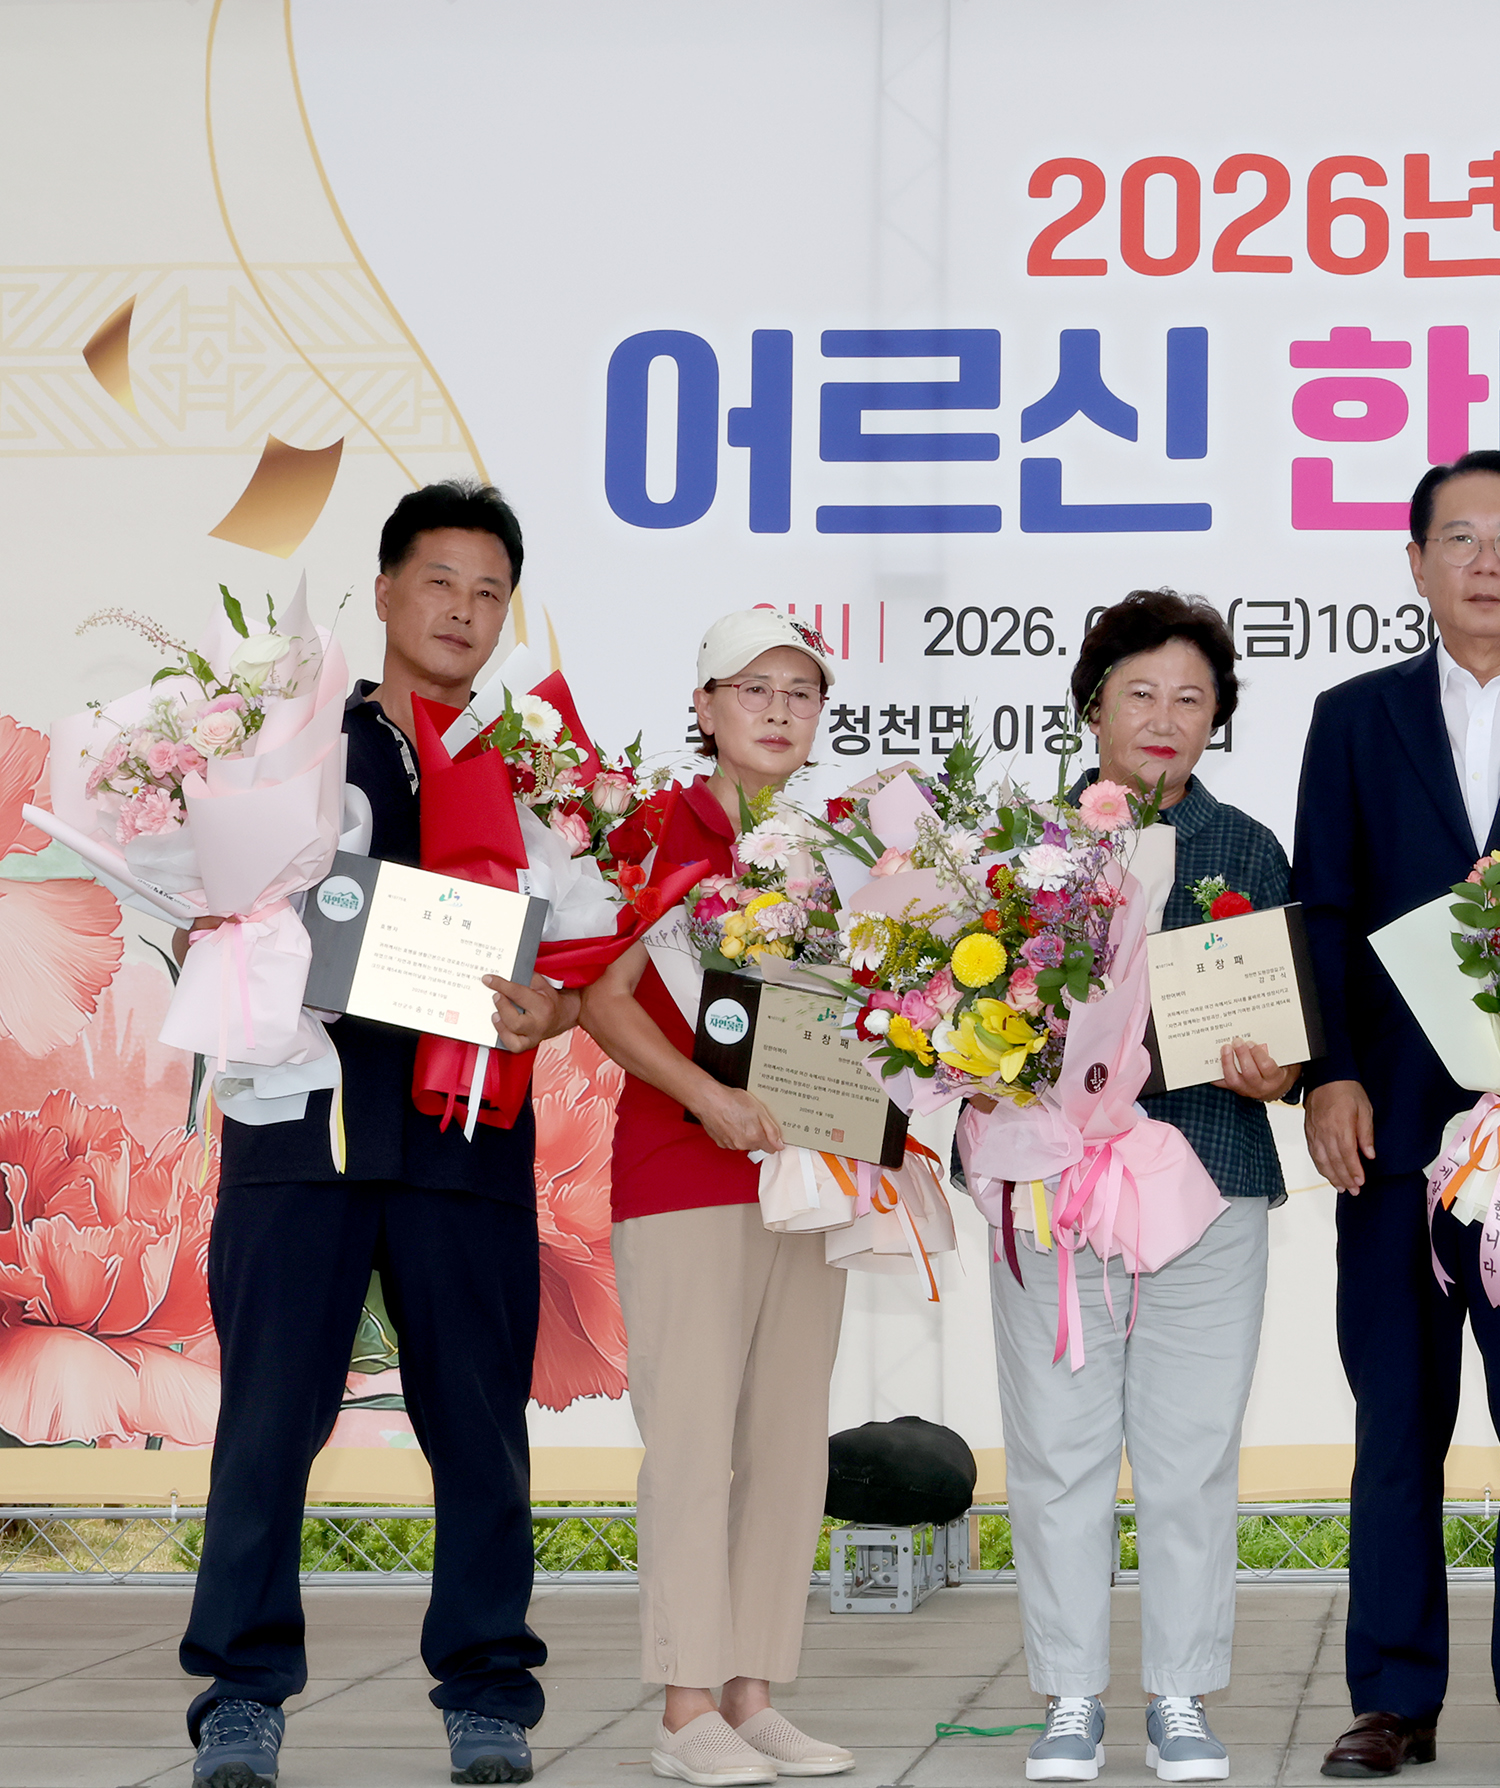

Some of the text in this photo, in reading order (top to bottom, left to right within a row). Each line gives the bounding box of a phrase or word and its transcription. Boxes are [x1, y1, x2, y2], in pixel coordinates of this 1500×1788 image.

[604, 327, 1212, 533] 어르신
[924, 606, 1067, 656] 2026.
[828, 703, 969, 756] 청천면
